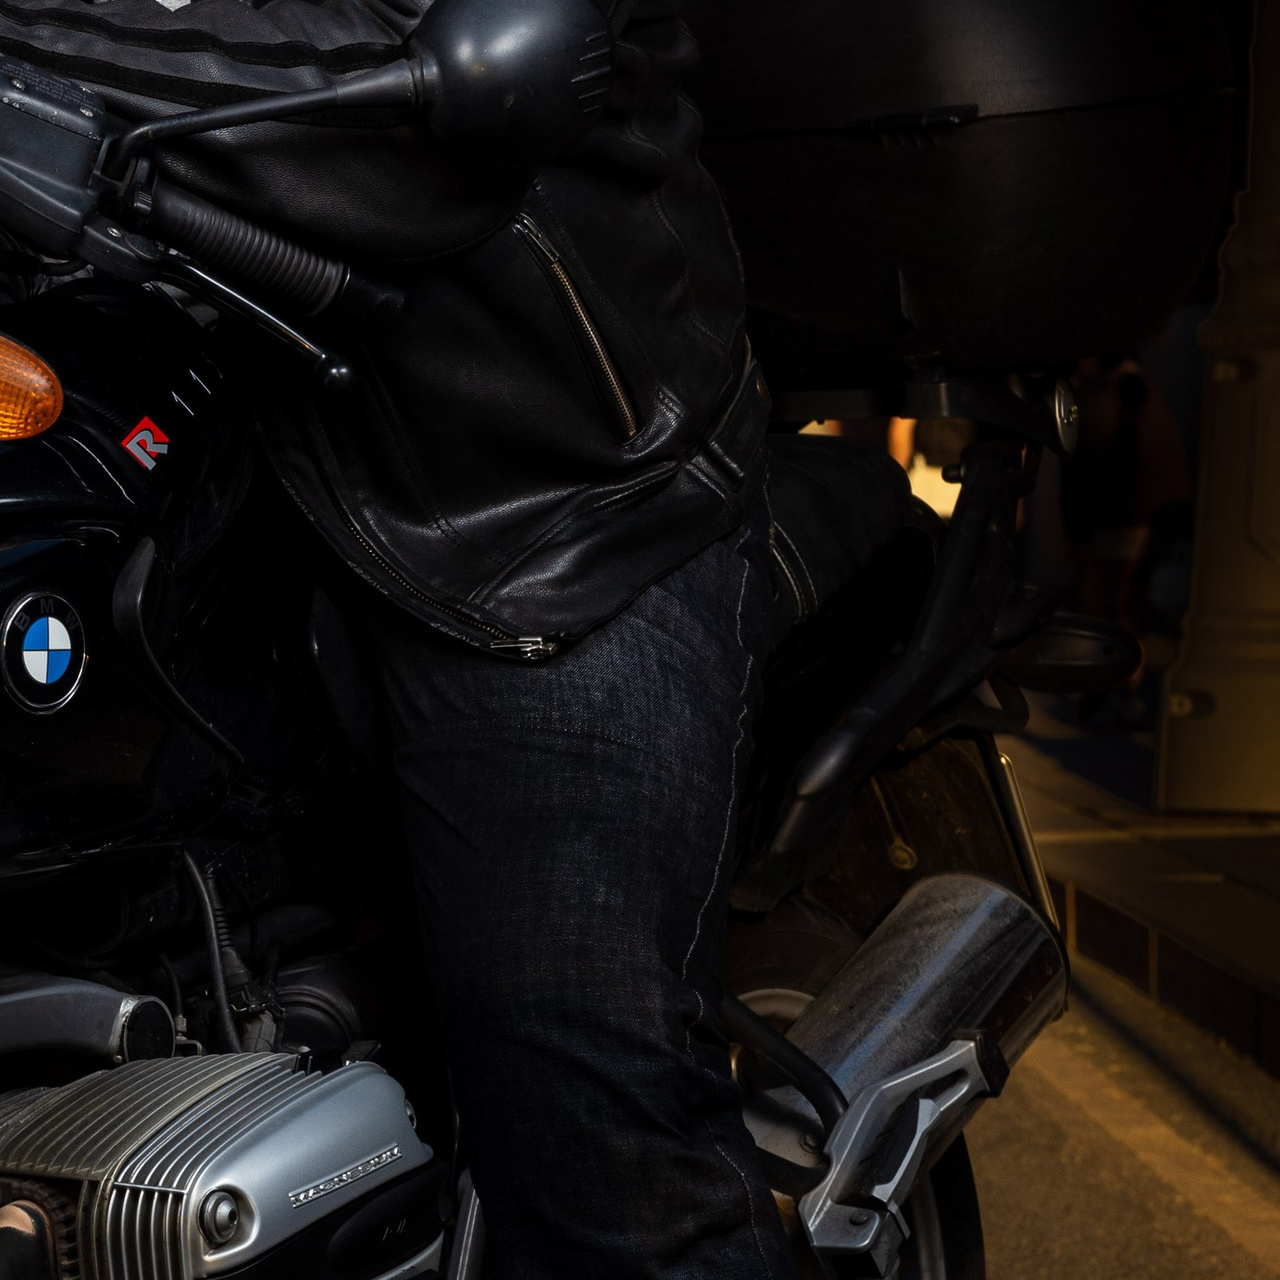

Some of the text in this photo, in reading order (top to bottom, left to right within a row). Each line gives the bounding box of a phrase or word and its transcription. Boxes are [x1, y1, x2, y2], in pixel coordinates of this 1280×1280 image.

[126, 367, 213, 471] R 11
[14, 597, 80, 633] BMW
[290, 1146, 403, 1207] MAGNESIUM
